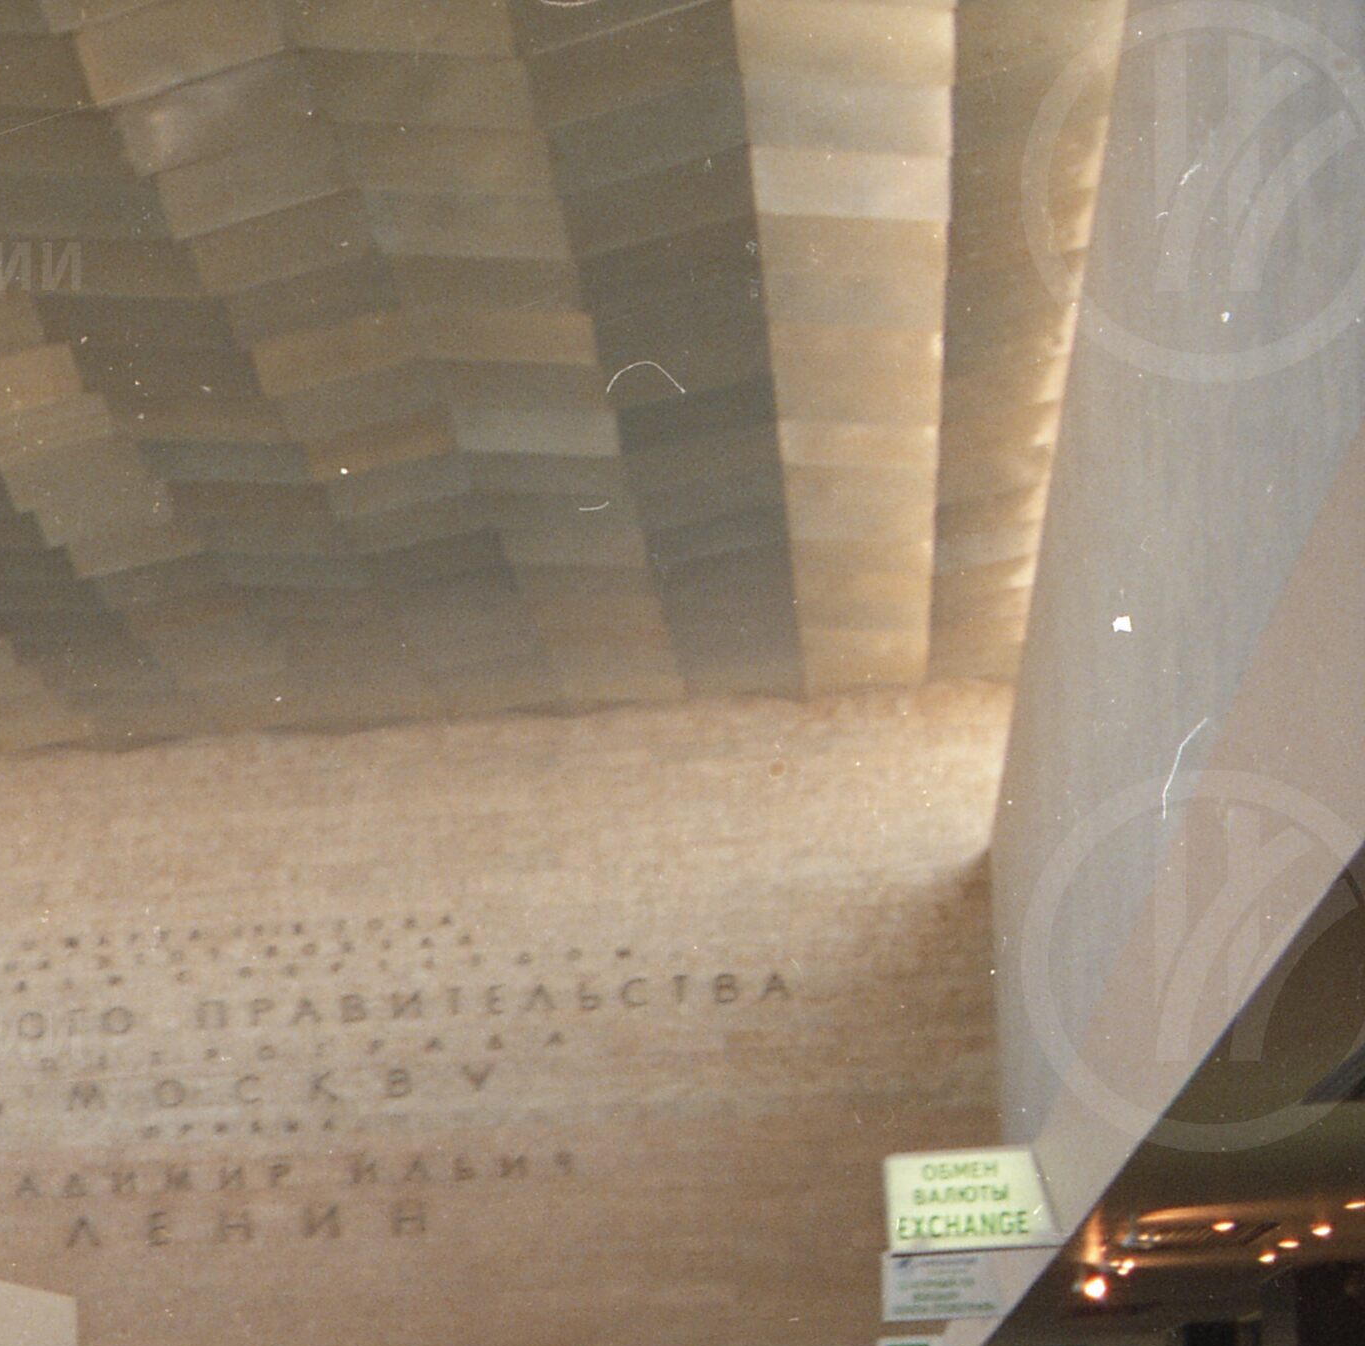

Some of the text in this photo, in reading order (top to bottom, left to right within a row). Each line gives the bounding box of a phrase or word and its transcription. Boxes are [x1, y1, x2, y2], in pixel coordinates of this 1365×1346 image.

[195, 971, 791, 1030] ПРАВИТЕЛЬСТВА
[66, 1063, 496, 1112] МОСКВУ
[921, 1160, 999, 1181] ОБМЕН
[913, 1184, 1010, 1206] ВАЛЮТЫ
[65, 1200, 429, 1249] ЛЕНИН
[898, 1209, 1030, 1240] EXCHANGE
